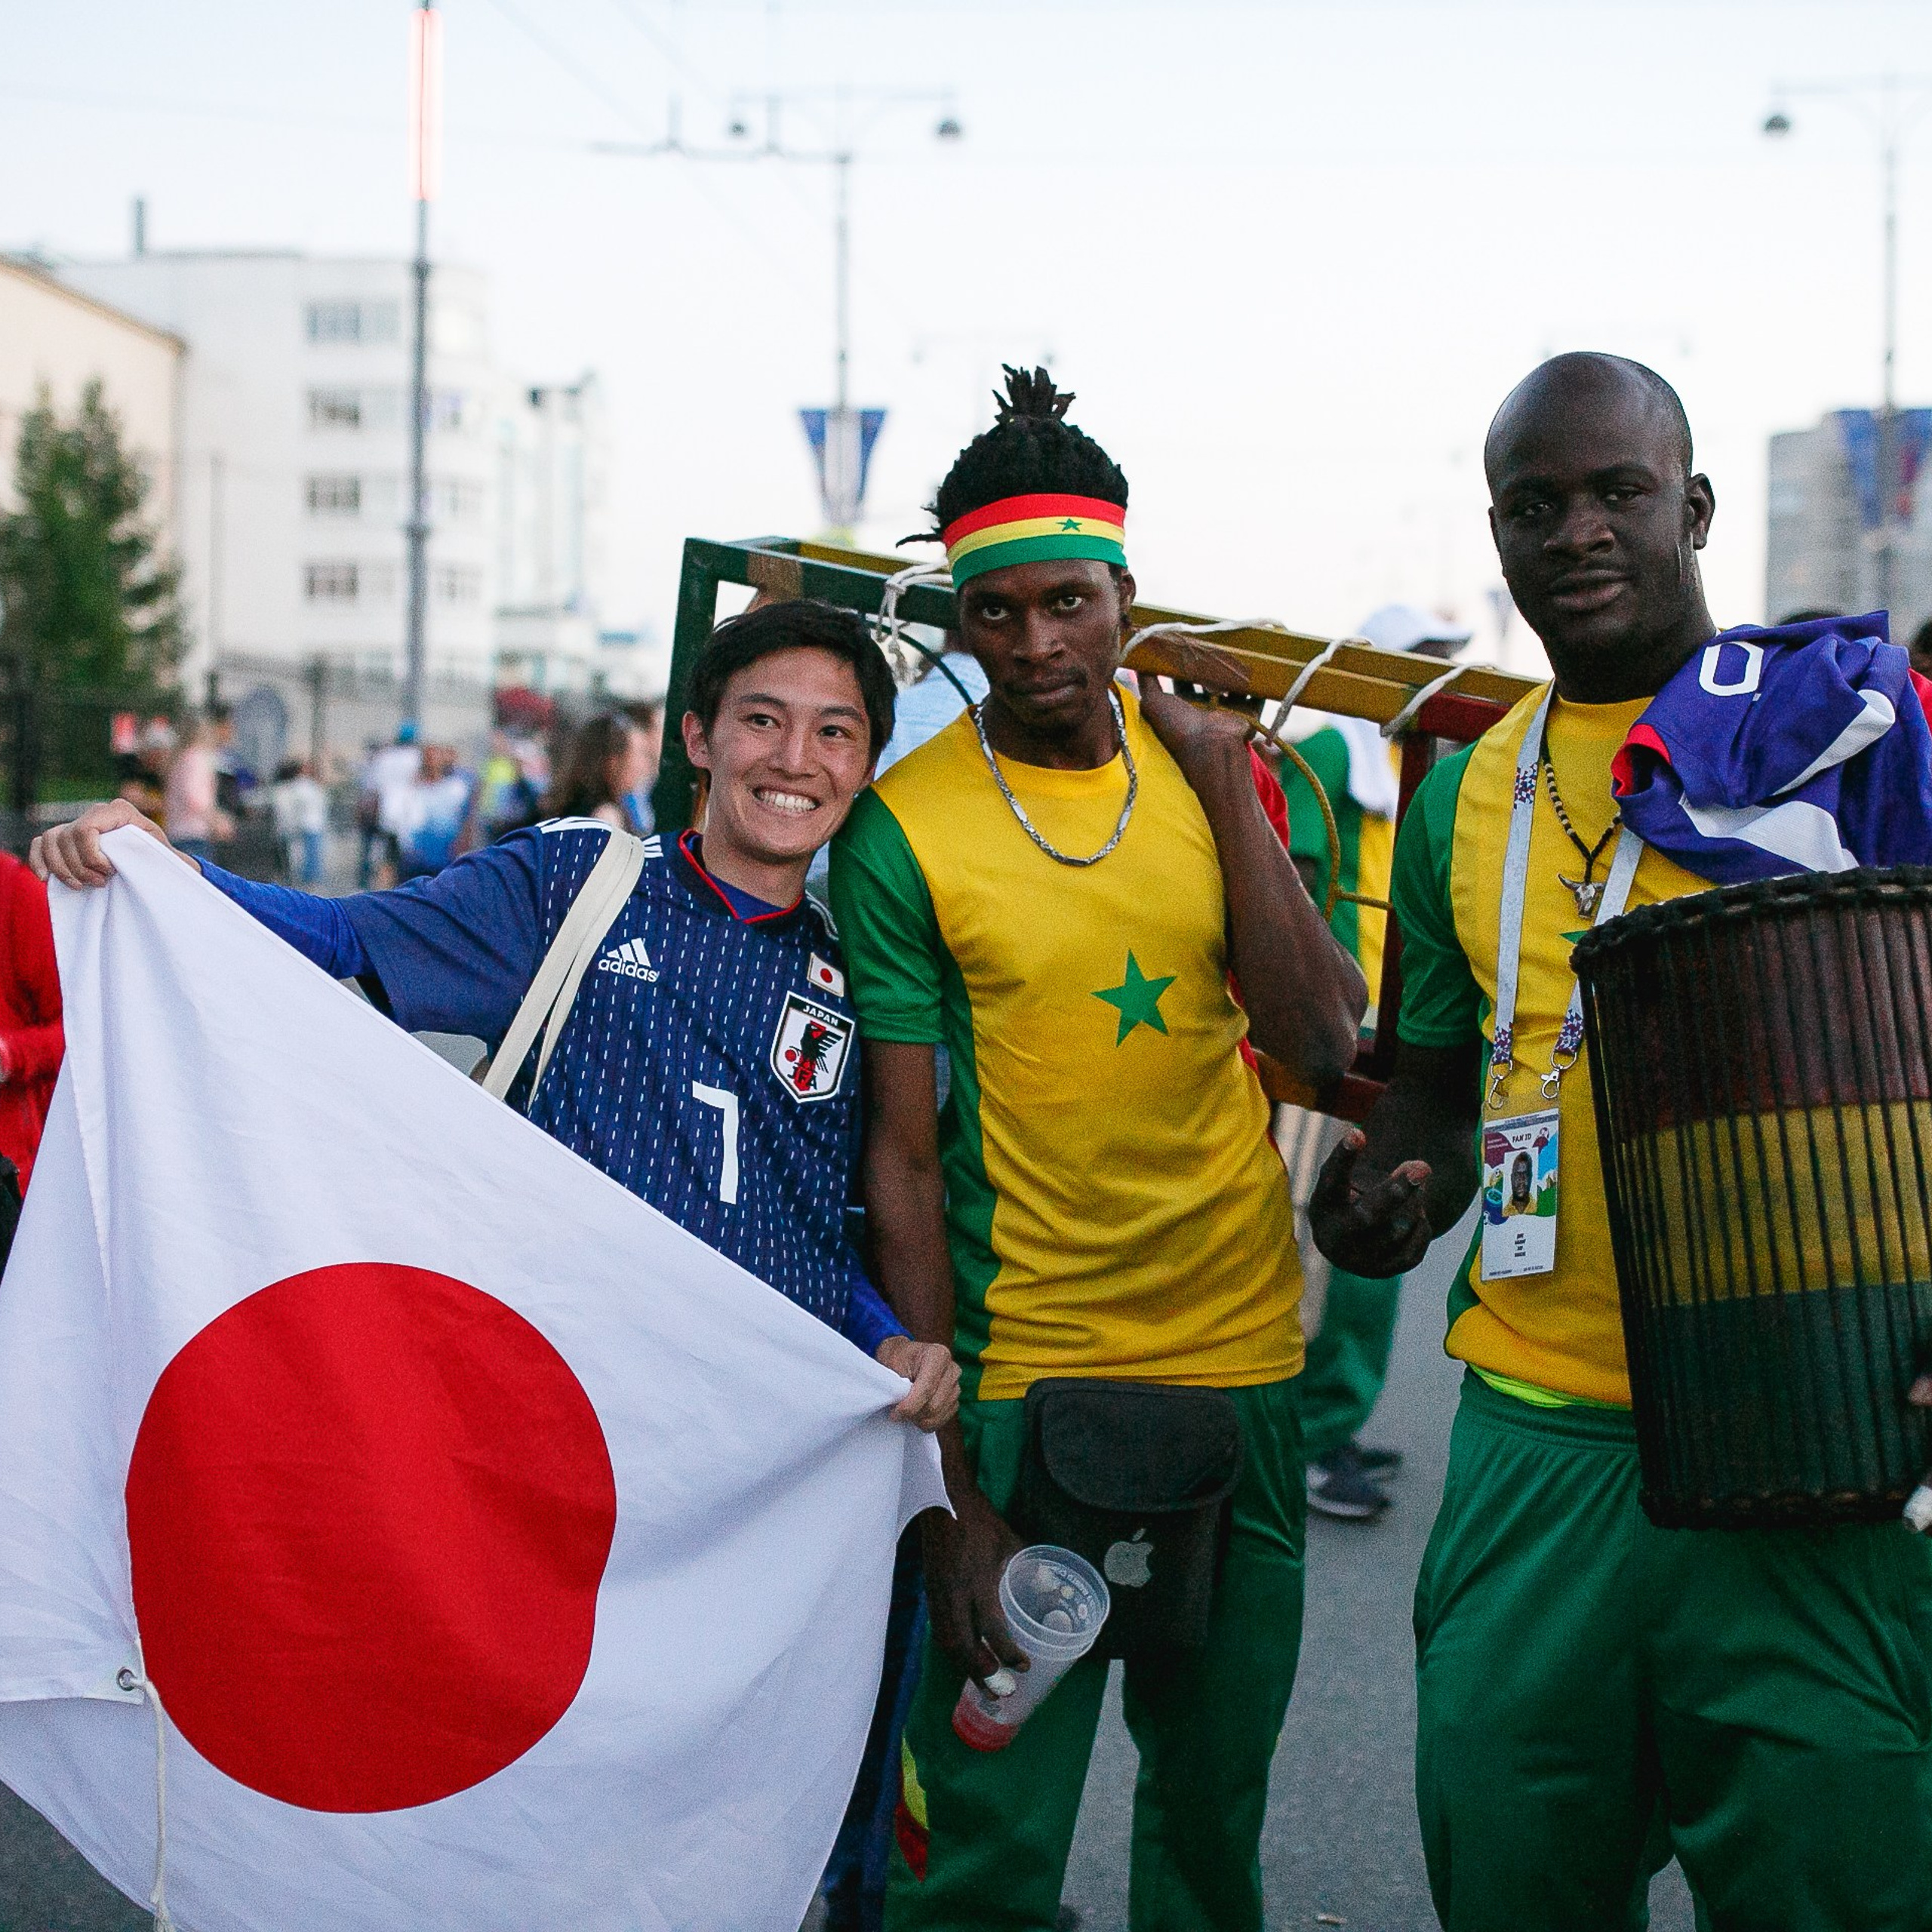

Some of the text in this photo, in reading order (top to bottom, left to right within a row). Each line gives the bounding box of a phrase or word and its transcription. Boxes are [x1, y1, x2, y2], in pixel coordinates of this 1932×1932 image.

[598, 958, 659, 983] adidas
[802, 1004, 839, 1026] JAPAN
[692, 1080, 739, 1204] 7
[1512, 1134, 1524, 1143] FAN
